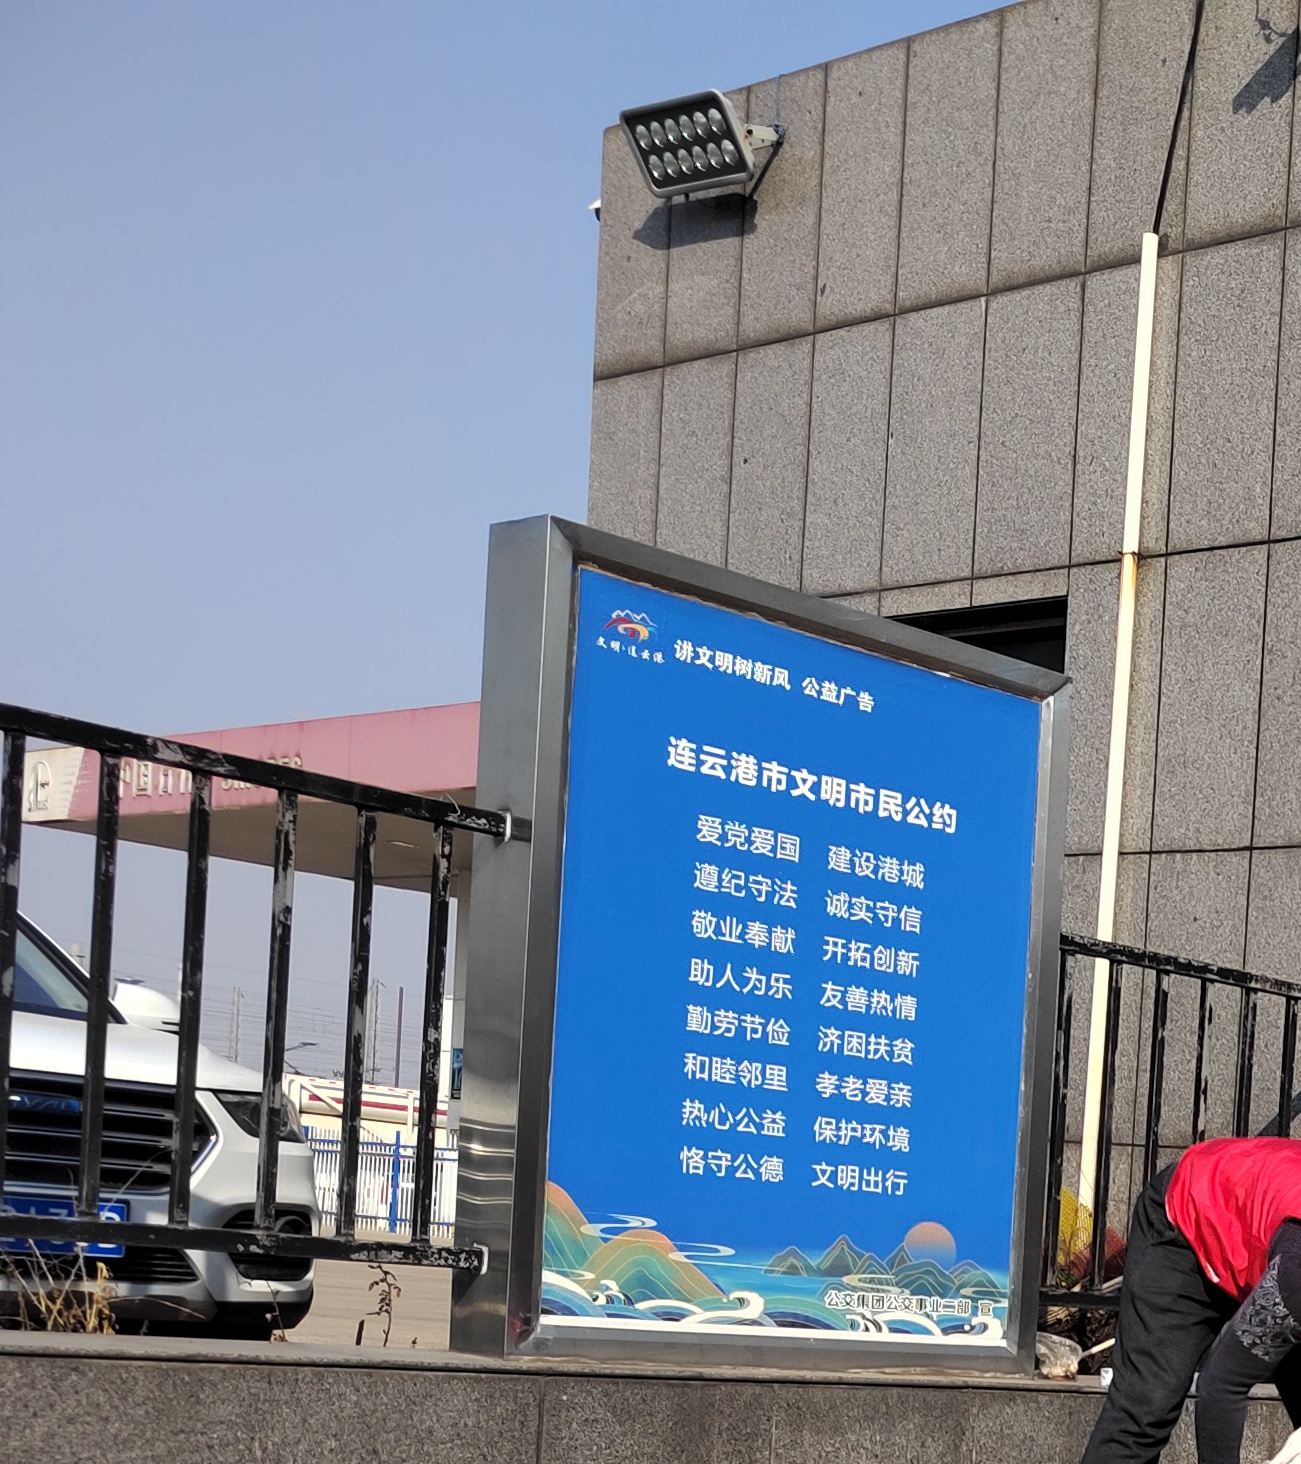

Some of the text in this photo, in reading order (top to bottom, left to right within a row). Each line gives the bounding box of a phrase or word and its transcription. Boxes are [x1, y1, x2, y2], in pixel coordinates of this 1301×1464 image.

[673, 638, 875, 713] 讲文明树新风 公益广告
[666, 736, 958, 834] 连云港市文明市民公约
[696, 814, 926, 891] 爱党爱国 建设港城
[693, 862, 923, 935] 遵纪守法 诚实守信
[691, 909, 920, 978] 敬业奉献 开拓创新
[688, 958, 918, 1021] 助人为乐 友善热情
[685, 1004, 916, 1066] 勤劳节俭 济困扶贫
[683, 1053, 913, 1109] 和睦邻里 孝老爱亲
[681, 1098, 911, 1153] 热心公益 保护环境
[680, 1145, 909, 1196] 恪守公德 文明出行
[825, 1290, 994, 1318] 公交集团公交事业二部 宣
